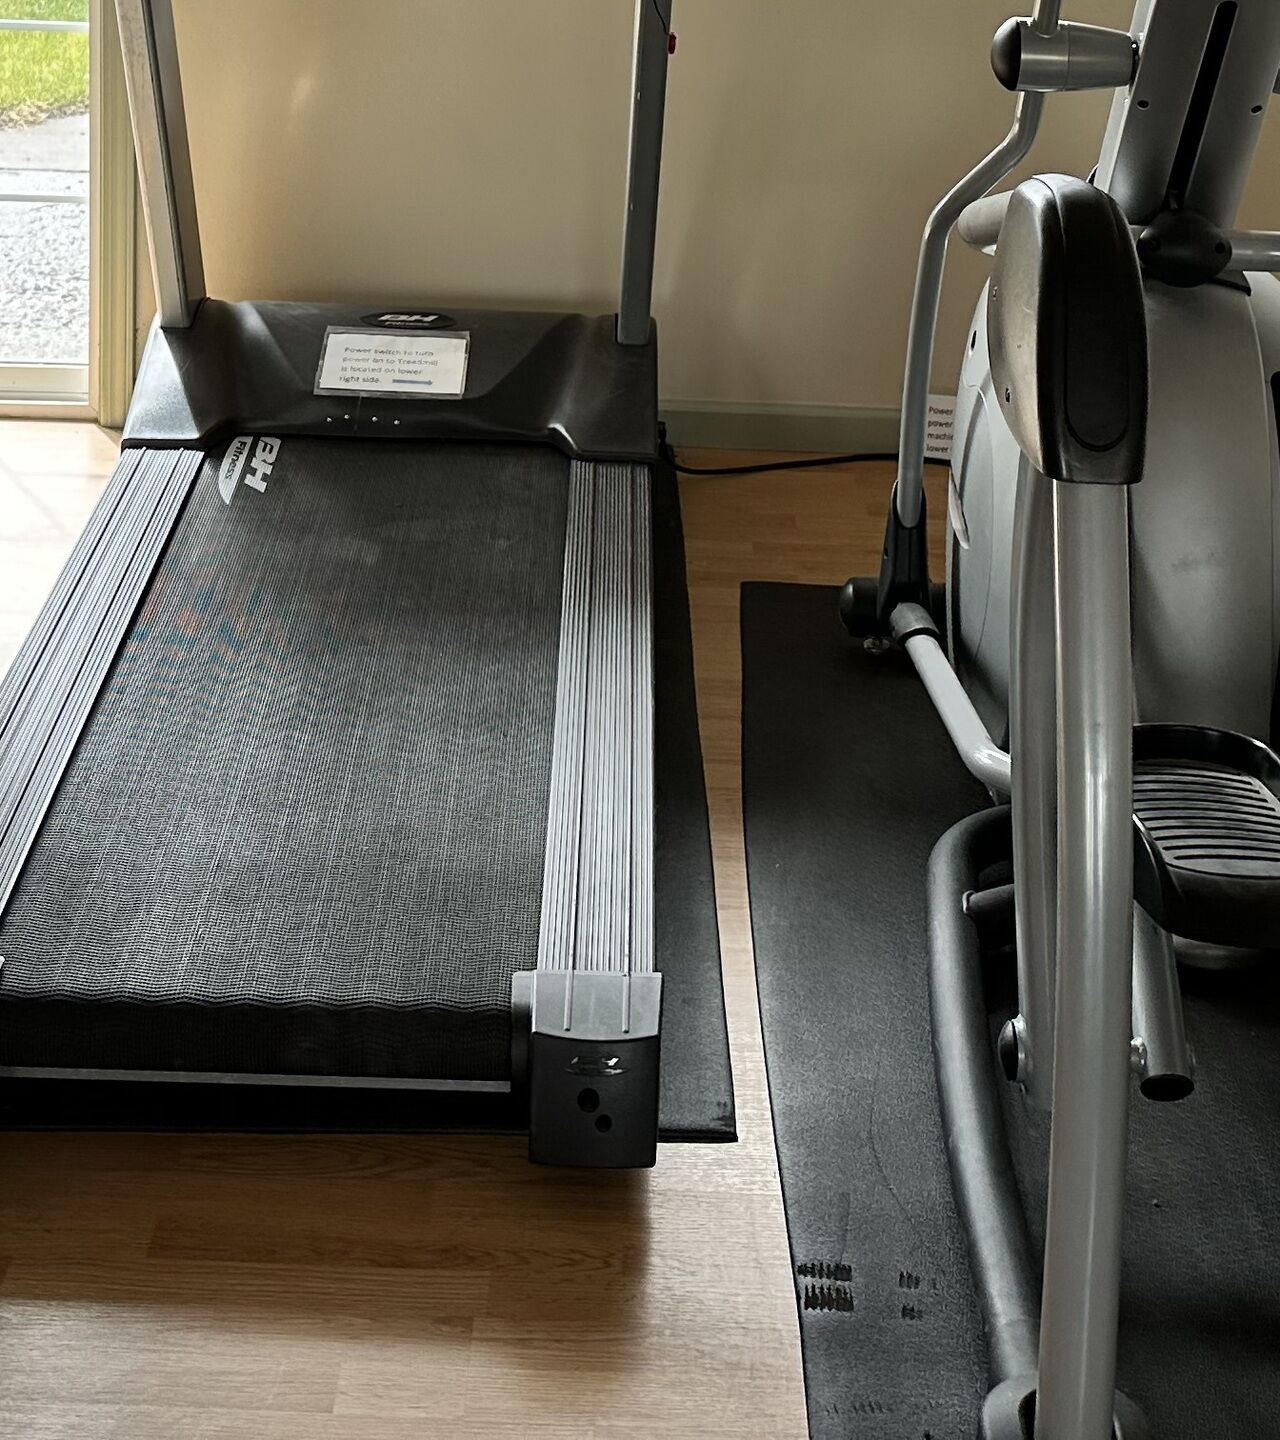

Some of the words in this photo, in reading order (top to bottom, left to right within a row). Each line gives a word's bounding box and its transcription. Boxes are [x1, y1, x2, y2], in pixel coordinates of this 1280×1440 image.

[378, 314, 440, 322] BH
[350, 366, 381, 374] located
[339, 376, 359, 384] right
[928, 406, 953, 415] Power
[927, 420, 953, 428] power
[926, 443, 949, 453] lower
[225, 440, 248, 480] Fitness
[244, 436, 281, 493] BH
